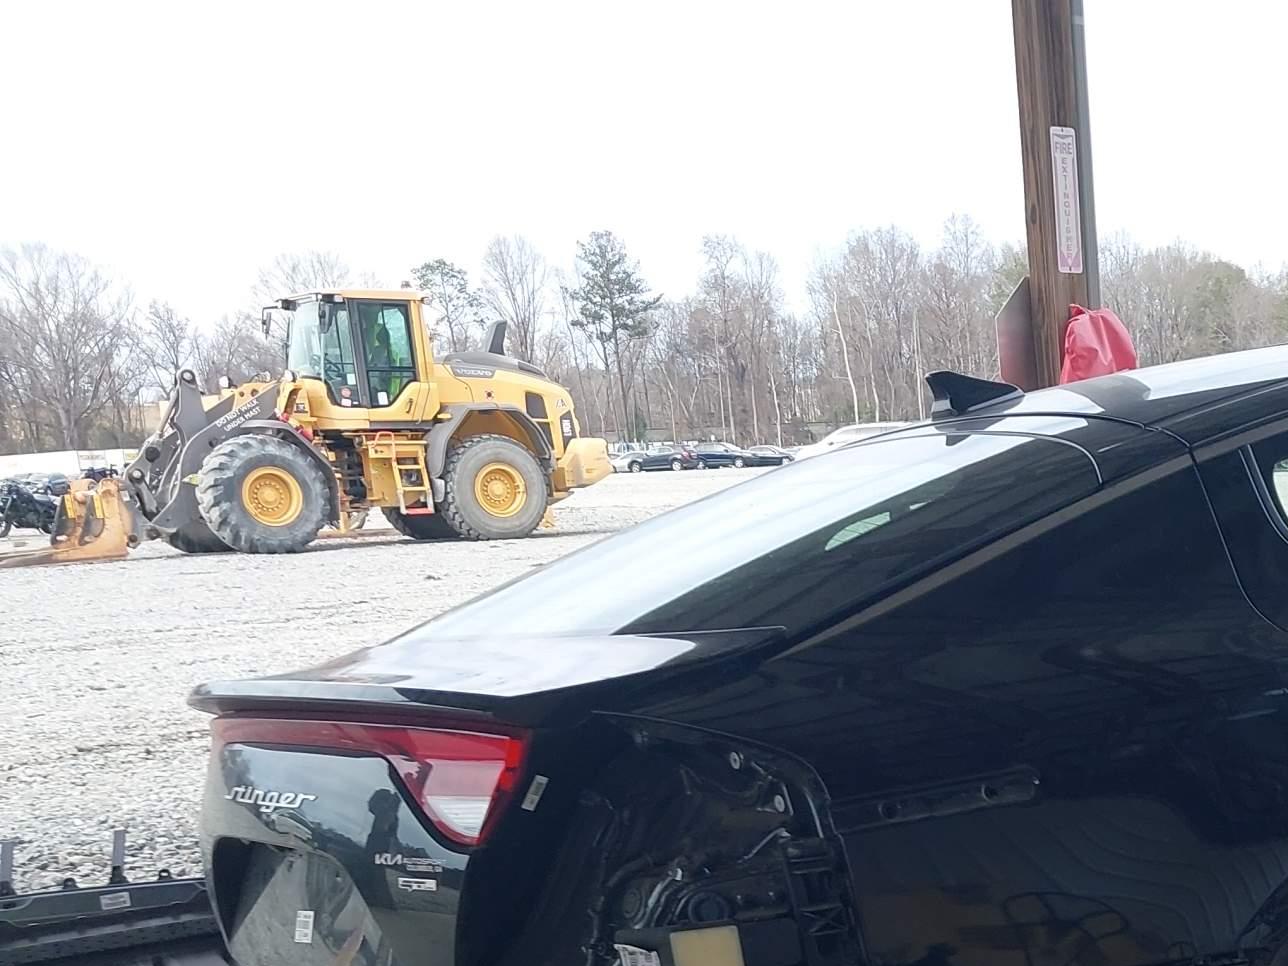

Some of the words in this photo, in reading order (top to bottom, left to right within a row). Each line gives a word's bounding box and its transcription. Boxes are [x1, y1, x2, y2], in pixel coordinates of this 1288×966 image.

[1054, 140, 1073, 155] FIRE
[455, 368, 493, 376] VOLVO
[226, 409, 241, 421] NOT
[239, 399, 259, 412] WALK
[223, 415, 246, 432] UNDER
[244, 406, 261, 420] MAST
[374, 852, 403, 865] KIA
